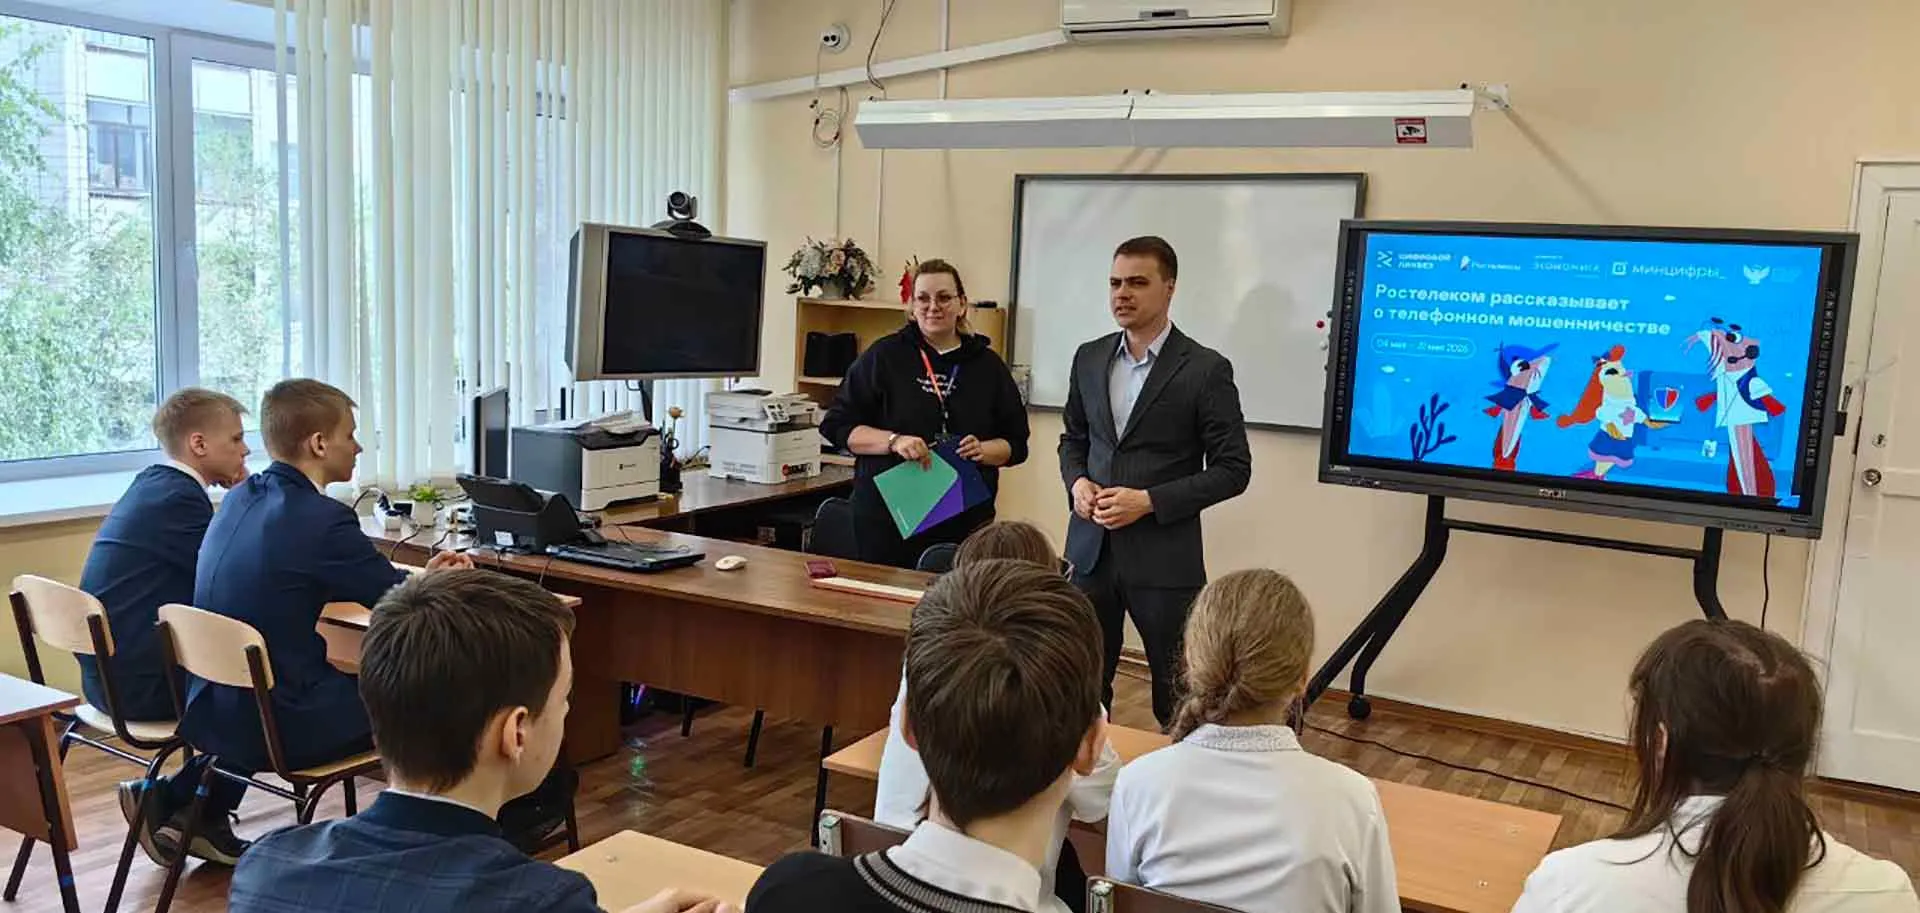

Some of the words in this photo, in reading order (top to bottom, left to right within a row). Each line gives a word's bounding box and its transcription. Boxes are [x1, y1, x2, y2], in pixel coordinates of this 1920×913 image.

[1375, 283, 1485, 303] Ростелеком
[1490, 292, 1630, 311] рассказывает
[1374, 307, 1384, 319] о
[1389, 307, 1504, 326] телефонном
[1508, 315, 1671, 335] мошенничестве
